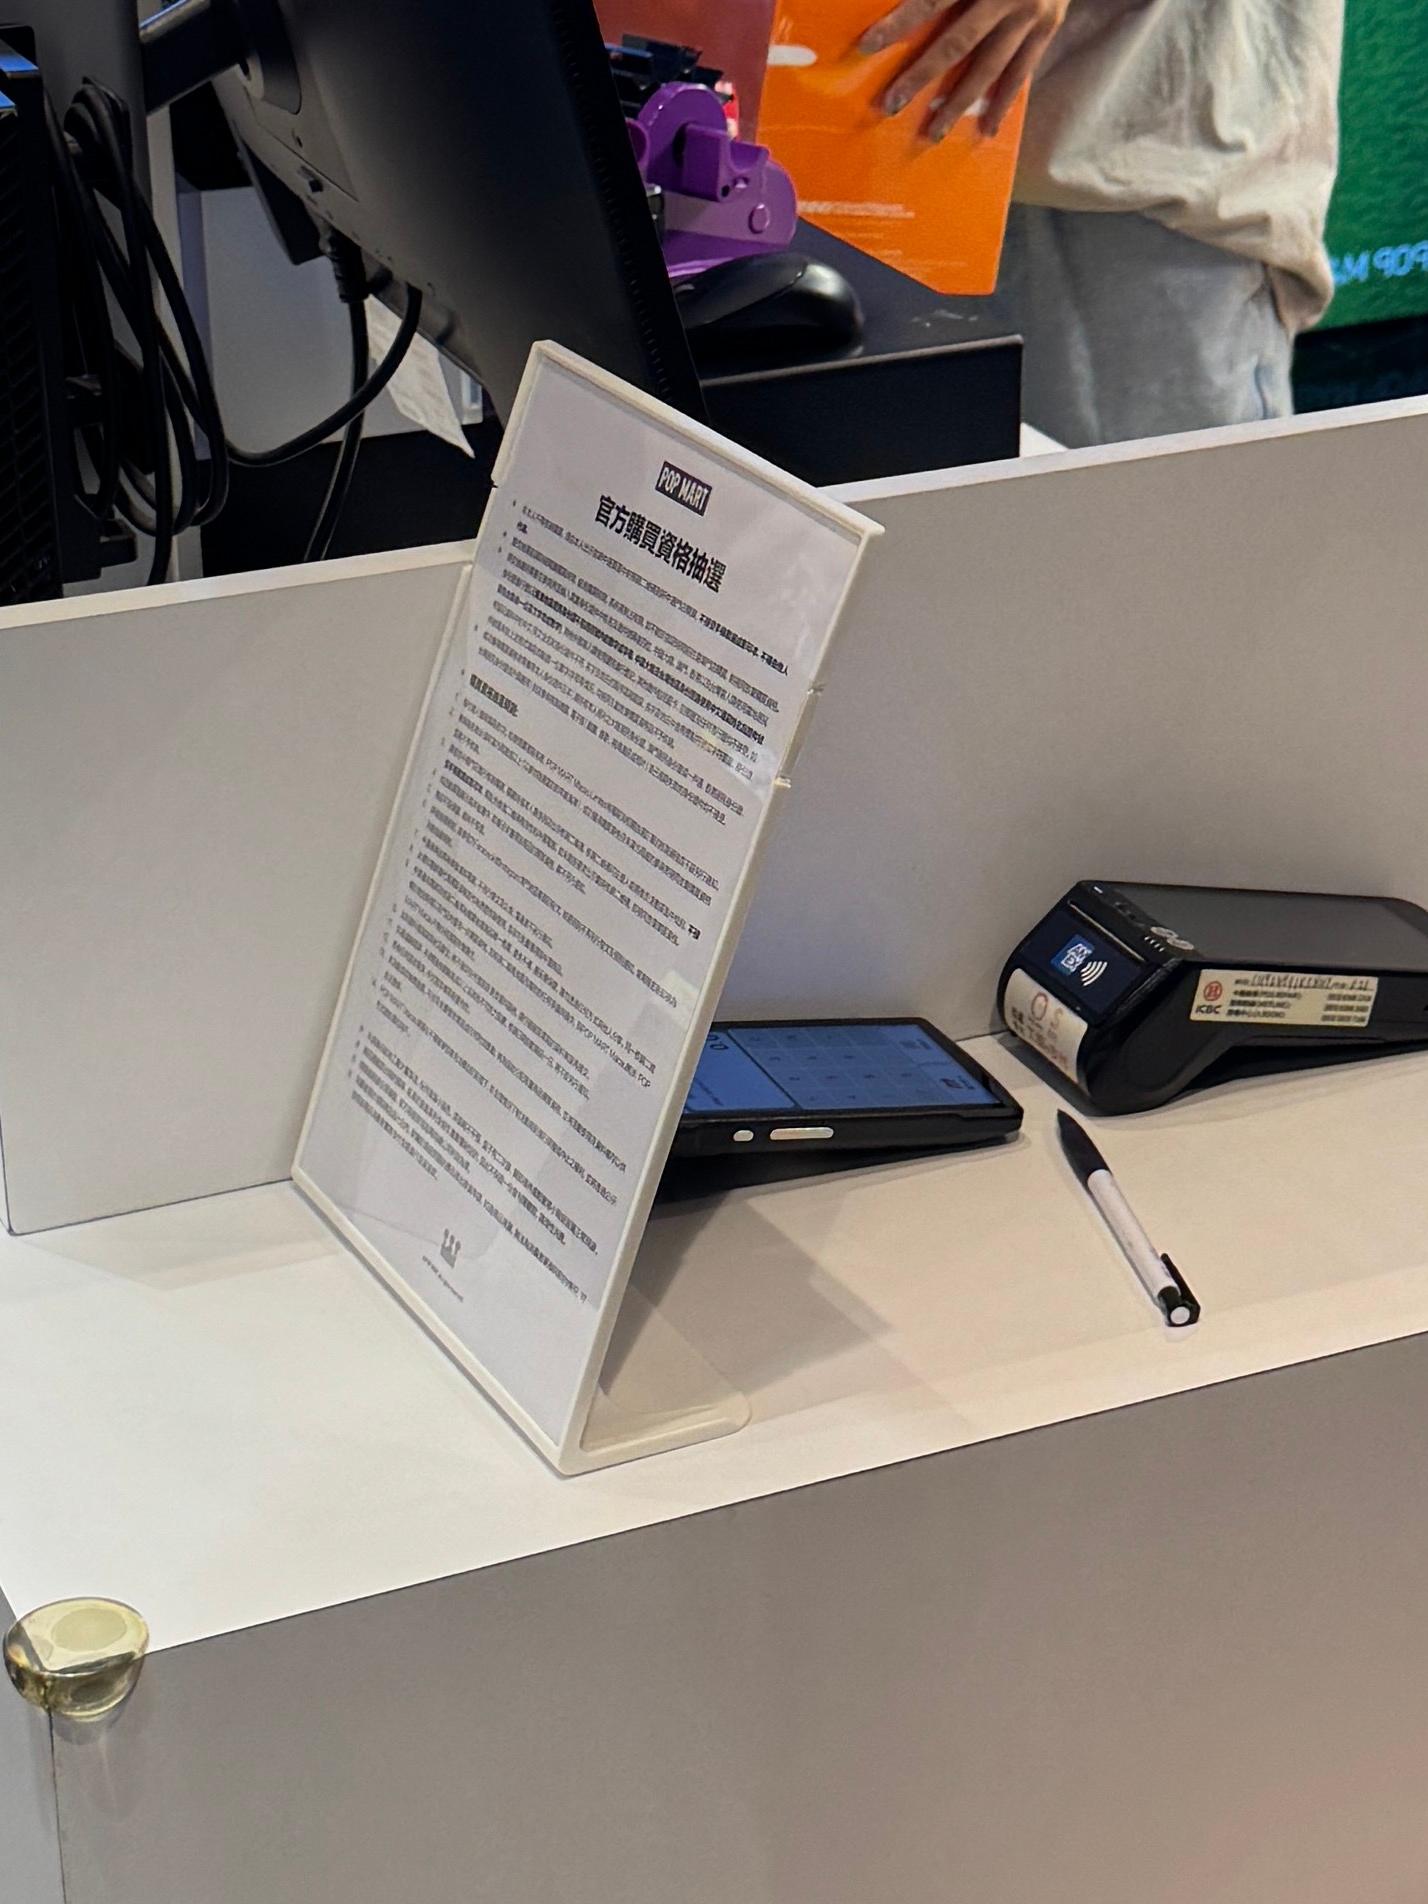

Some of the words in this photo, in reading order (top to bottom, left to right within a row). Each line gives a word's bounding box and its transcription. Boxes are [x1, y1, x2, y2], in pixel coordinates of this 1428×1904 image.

[658, 466, 681, 495] POP
[677, 477, 709, 511] MART
[594, 494, 727, 594] 官方購買資格抽選
